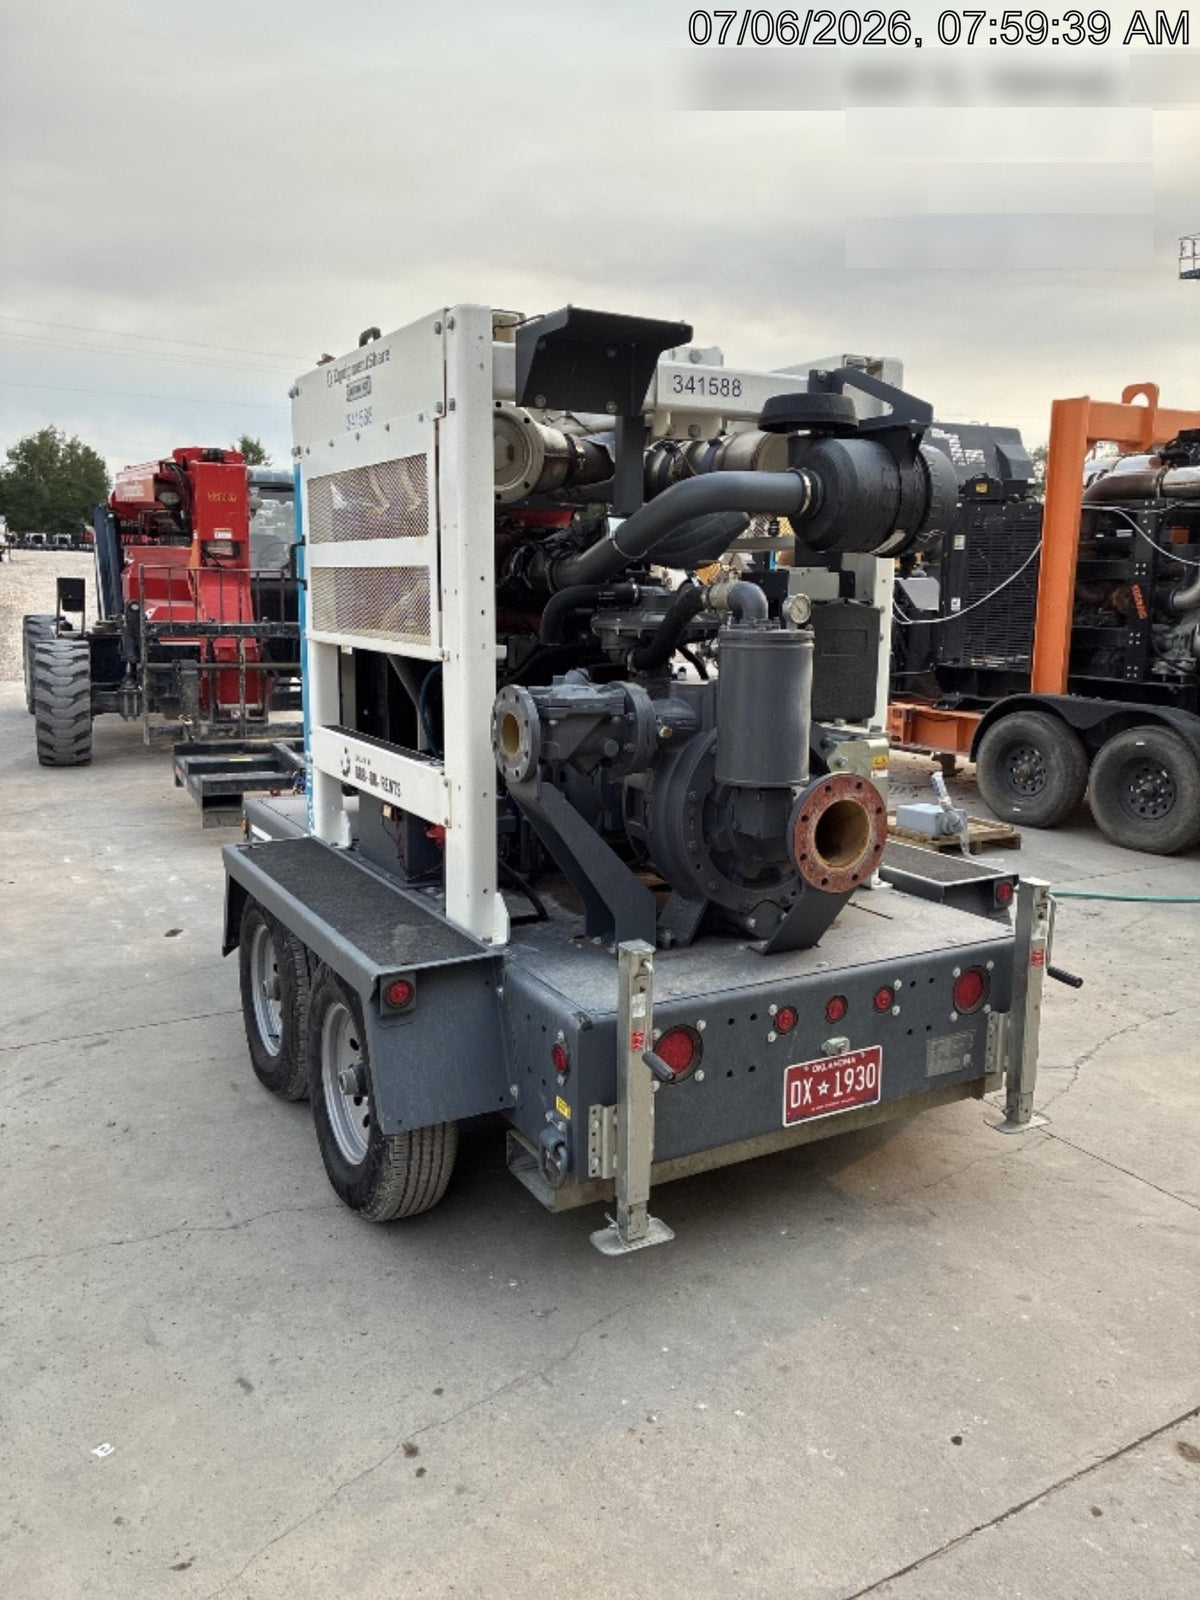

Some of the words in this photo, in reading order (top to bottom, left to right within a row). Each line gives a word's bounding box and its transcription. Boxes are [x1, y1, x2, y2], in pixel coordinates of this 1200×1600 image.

[673, 374, 743, 397] 341588
[812, 1056, 857, 1073] OKLAHOMA
[790, 1076, 813, 1108] DX
[832, 1062, 876, 1098] 1930
